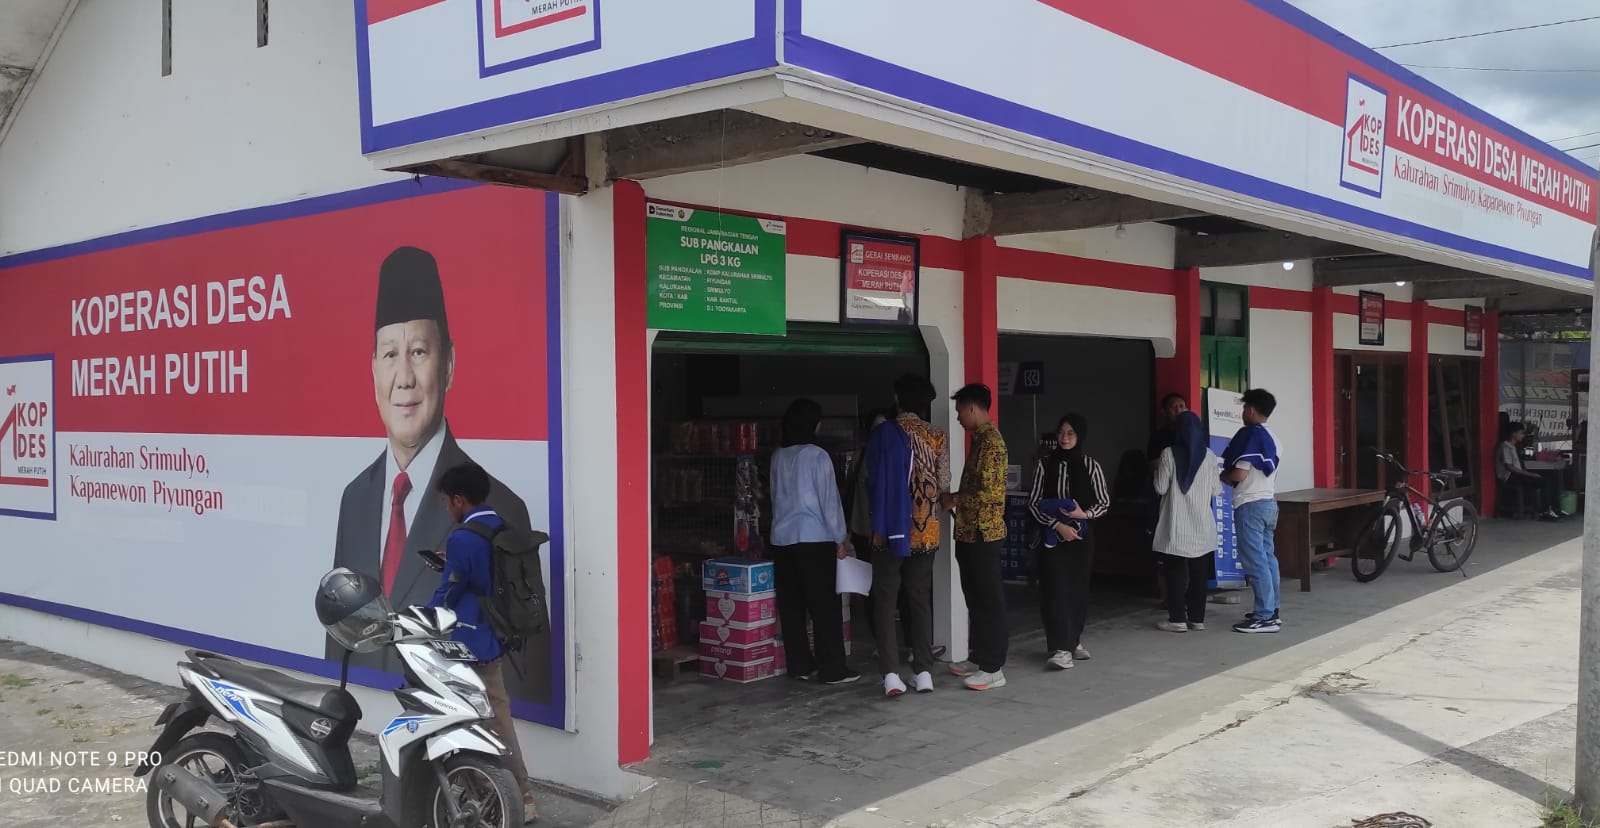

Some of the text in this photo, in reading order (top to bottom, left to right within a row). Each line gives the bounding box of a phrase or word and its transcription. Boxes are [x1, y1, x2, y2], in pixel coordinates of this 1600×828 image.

[531, 1, 558, 14] MERAH
[1364, 113, 1382, 135] KOP
[1363, 135, 1380, 156] DES
[1396, 96, 1590, 213] KOPERASI DESA MERAH PUTIH
[1394, 155, 1439, 192] Kalurahan
[1478, 186, 1515, 216] Kapanewon
[1516, 201, 1543, 228] Piyungan
[680, 236, 759, 255] SUB PANGKALAN
[700, 253, 741, 267] LPG 3 KG
[858, 269, 889, 278] KOPERASI
[71, 273, 292, 337] KOPERASI DESA
[71, 349, 249, 397] MERAH PUTIH
[17, 401, 48, 427] KOP
[17, 433, 46, 458] DES
[69, 444, 209, 479] Kalurahan Srimulyo,
[69, 474, 223, 515] Kapanewon Piyungan
